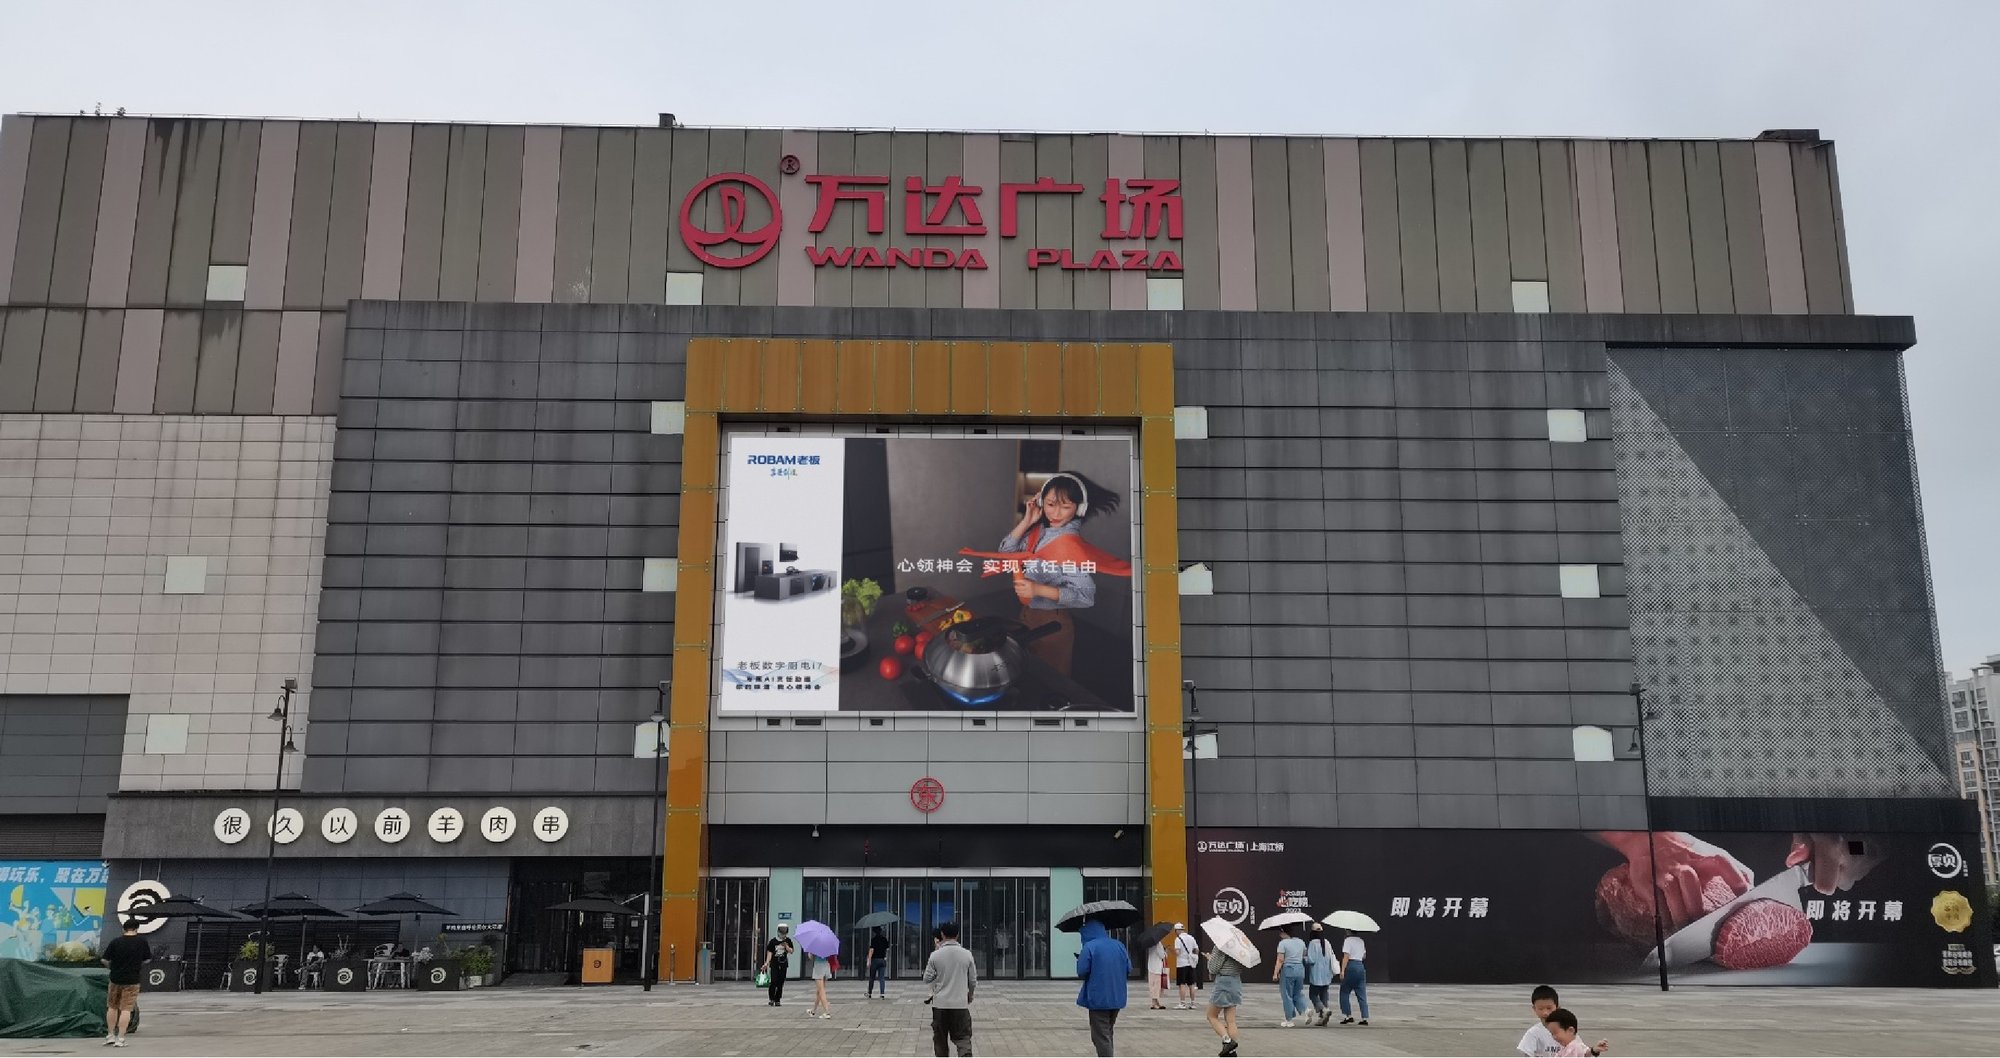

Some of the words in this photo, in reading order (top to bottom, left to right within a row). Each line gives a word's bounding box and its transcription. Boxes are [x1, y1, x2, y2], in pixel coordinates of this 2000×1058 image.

[805, 175, 1184, 239] 万达广场
[805, 246, 988, 270] WANDA
[1028, 248, 1185, 271] PLAZA
[897, 558, 974, 574] 心领神会
[983, 558, 1097, 575] 实现烹饪自由
[221, 813, 561, 837] 很久以前羊肉串
[1390, 897, 1489, 918] 即将开幕
[1806, 900, 1903, 921] 即将开幕
